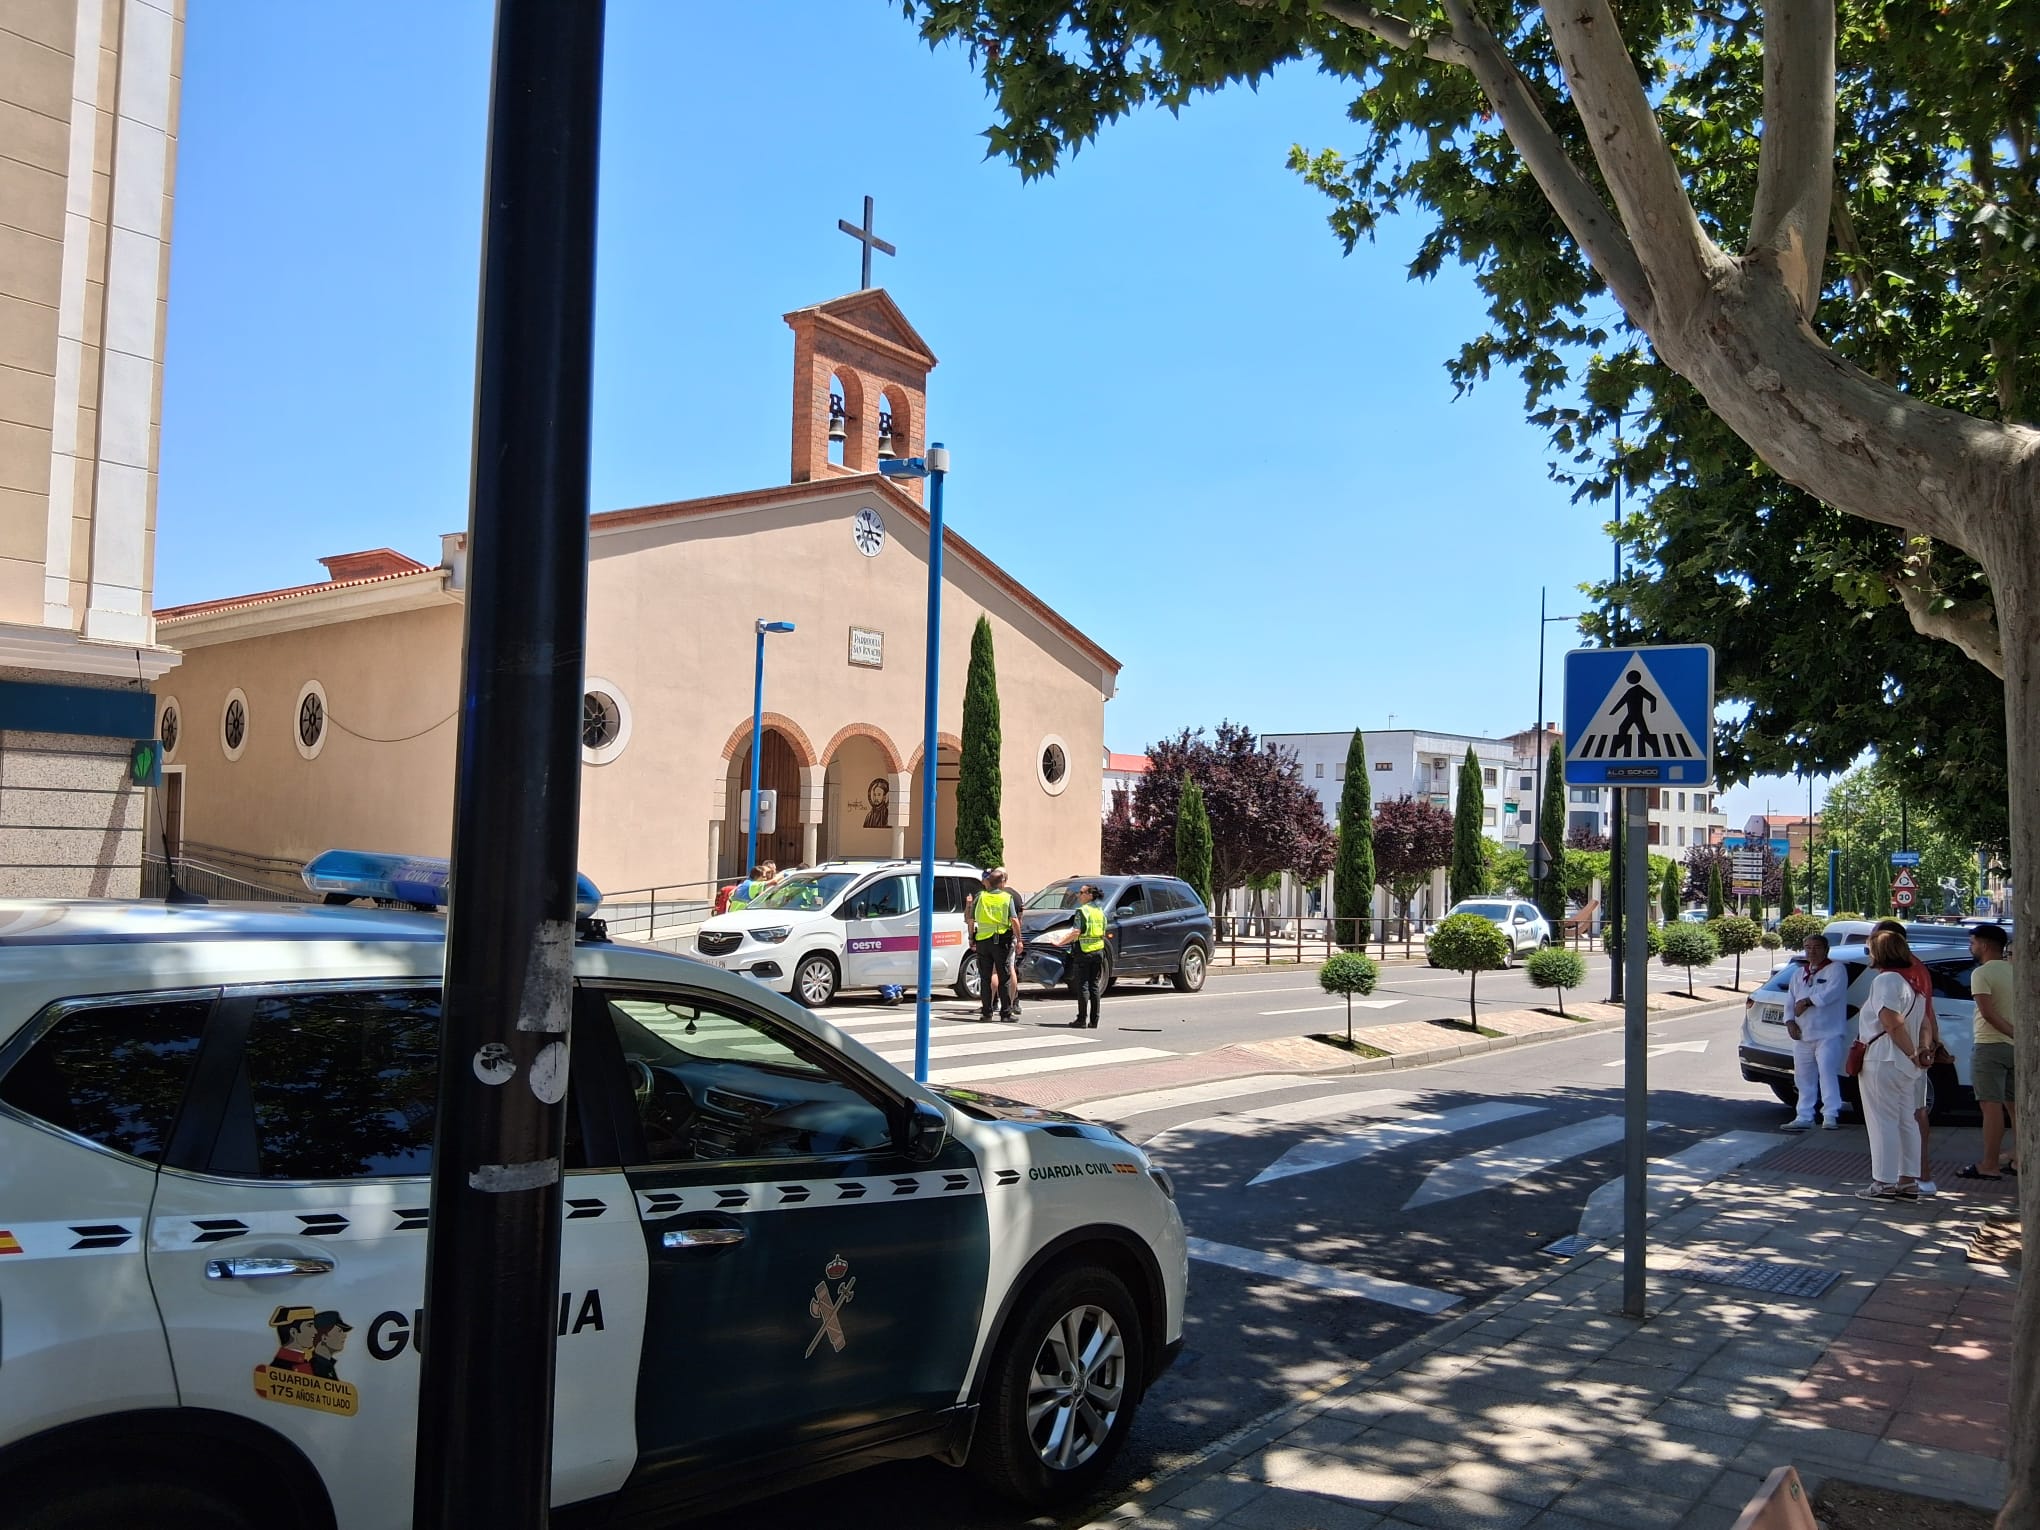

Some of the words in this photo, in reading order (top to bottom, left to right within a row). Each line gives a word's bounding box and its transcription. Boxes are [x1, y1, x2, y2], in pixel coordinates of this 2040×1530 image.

[1029, 1165, 1083, 1180] GUARDIA
[1085, 1163, 1112, 1175] CIVIL
[269, 1371, 321, 1389] GUARDIA
[324, 1381, 352, 1395] CIVIL
[270, 1384, 294, 1398] 175
[296, 1389, 315, 1403] AÑOS
[316, 1395, 321, 1404] A
[322, 1395, 331, 1406] TU
[332, 1398, 350, 1409] LADO
